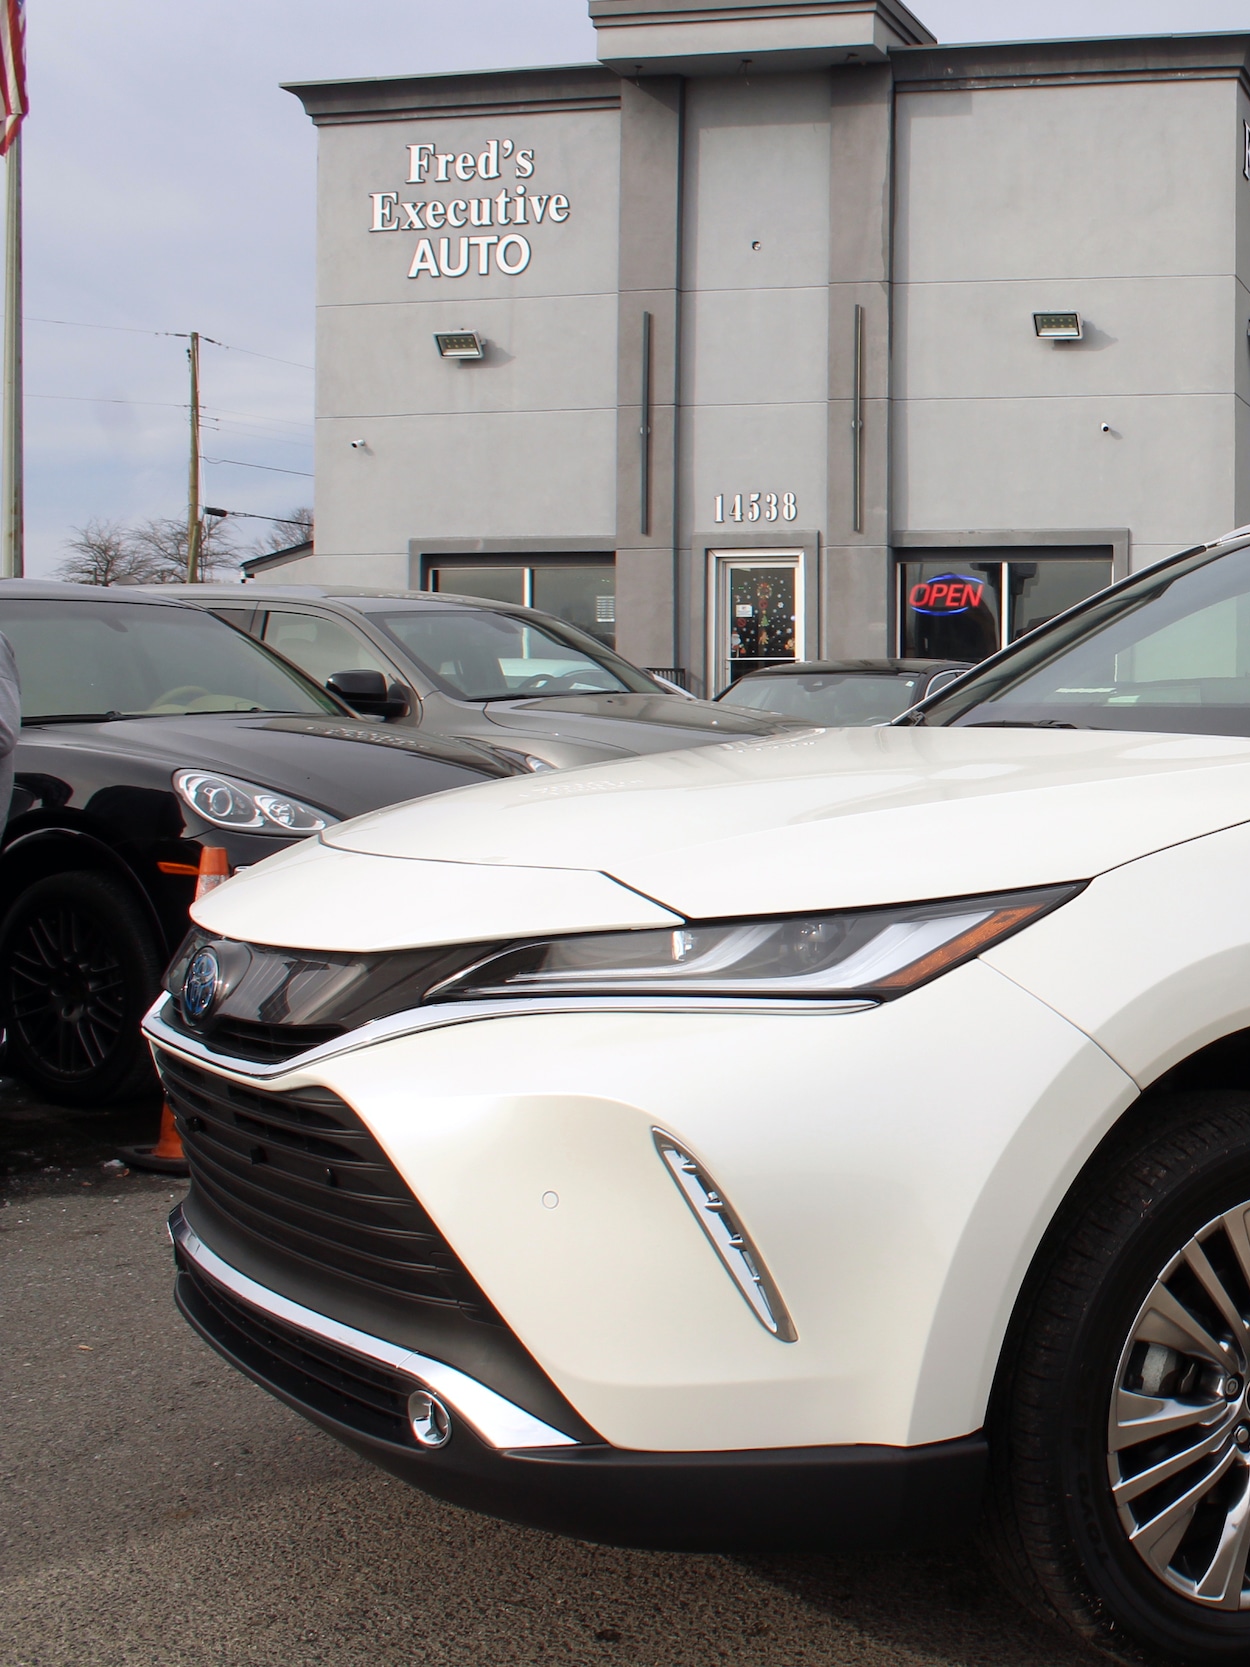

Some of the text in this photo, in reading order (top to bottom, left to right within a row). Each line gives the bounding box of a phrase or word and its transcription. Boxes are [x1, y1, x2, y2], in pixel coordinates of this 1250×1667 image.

[405, 139, 535, 184] Fred's
[368, 185, 570, 232] Executive
[407, 234, 532, 279] AUTO
[714, 491, 797, 523] 14538
[909, 583, 984, 607] OPEN
